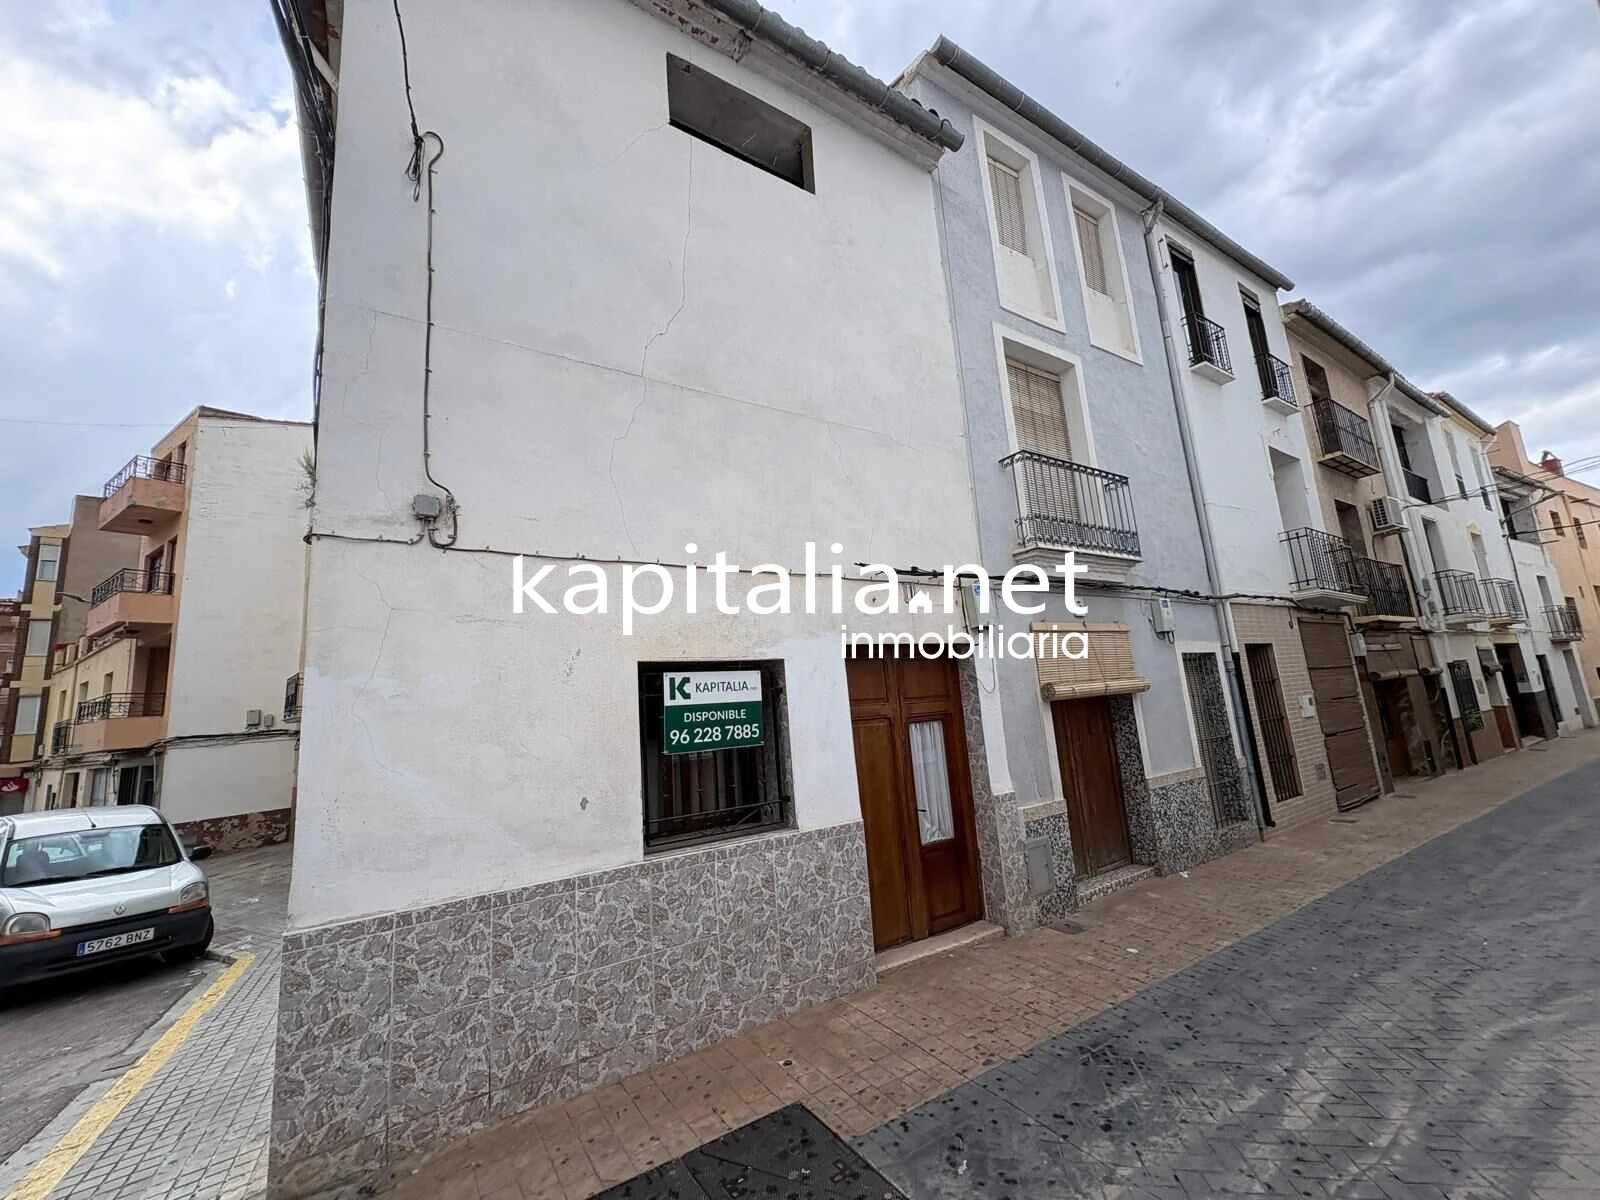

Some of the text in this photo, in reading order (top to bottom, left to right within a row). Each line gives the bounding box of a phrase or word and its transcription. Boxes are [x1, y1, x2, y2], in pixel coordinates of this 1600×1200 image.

[668, 676, 749, 700] K KAPITALIA
[683, 709, 747, 722] DISPONIBLE
[669, 723, 760, 745] 96 228 7885
[87, 930, 151, 952] 5762 BNZ
